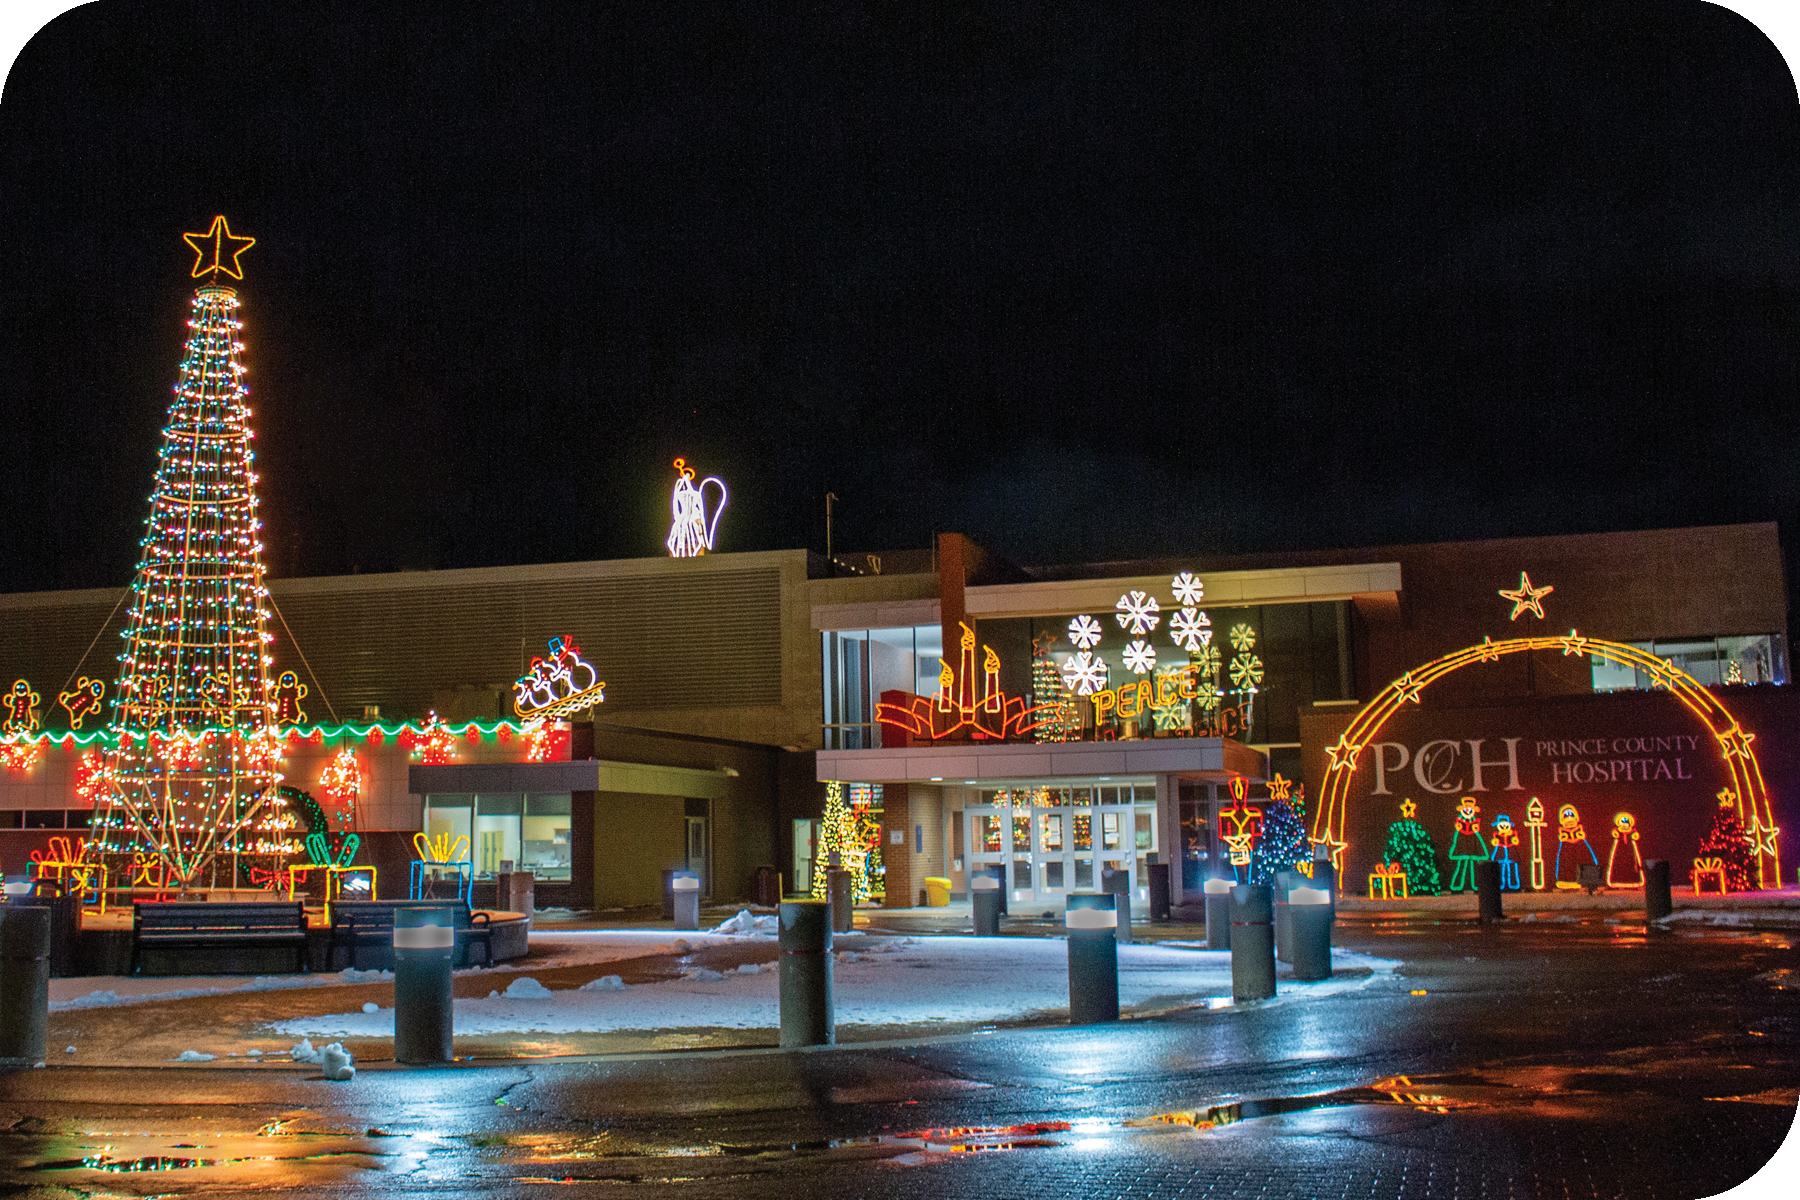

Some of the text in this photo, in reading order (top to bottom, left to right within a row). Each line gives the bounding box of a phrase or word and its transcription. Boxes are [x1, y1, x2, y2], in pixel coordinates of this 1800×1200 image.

[1091, 664, 1199, 726] PEACE
[1369, 737, 1526, 796] PCH
[1536, 735, 1699, 757] PRINCE COUNTY
[1552, 757, 1692, 784] HOSPITAL
